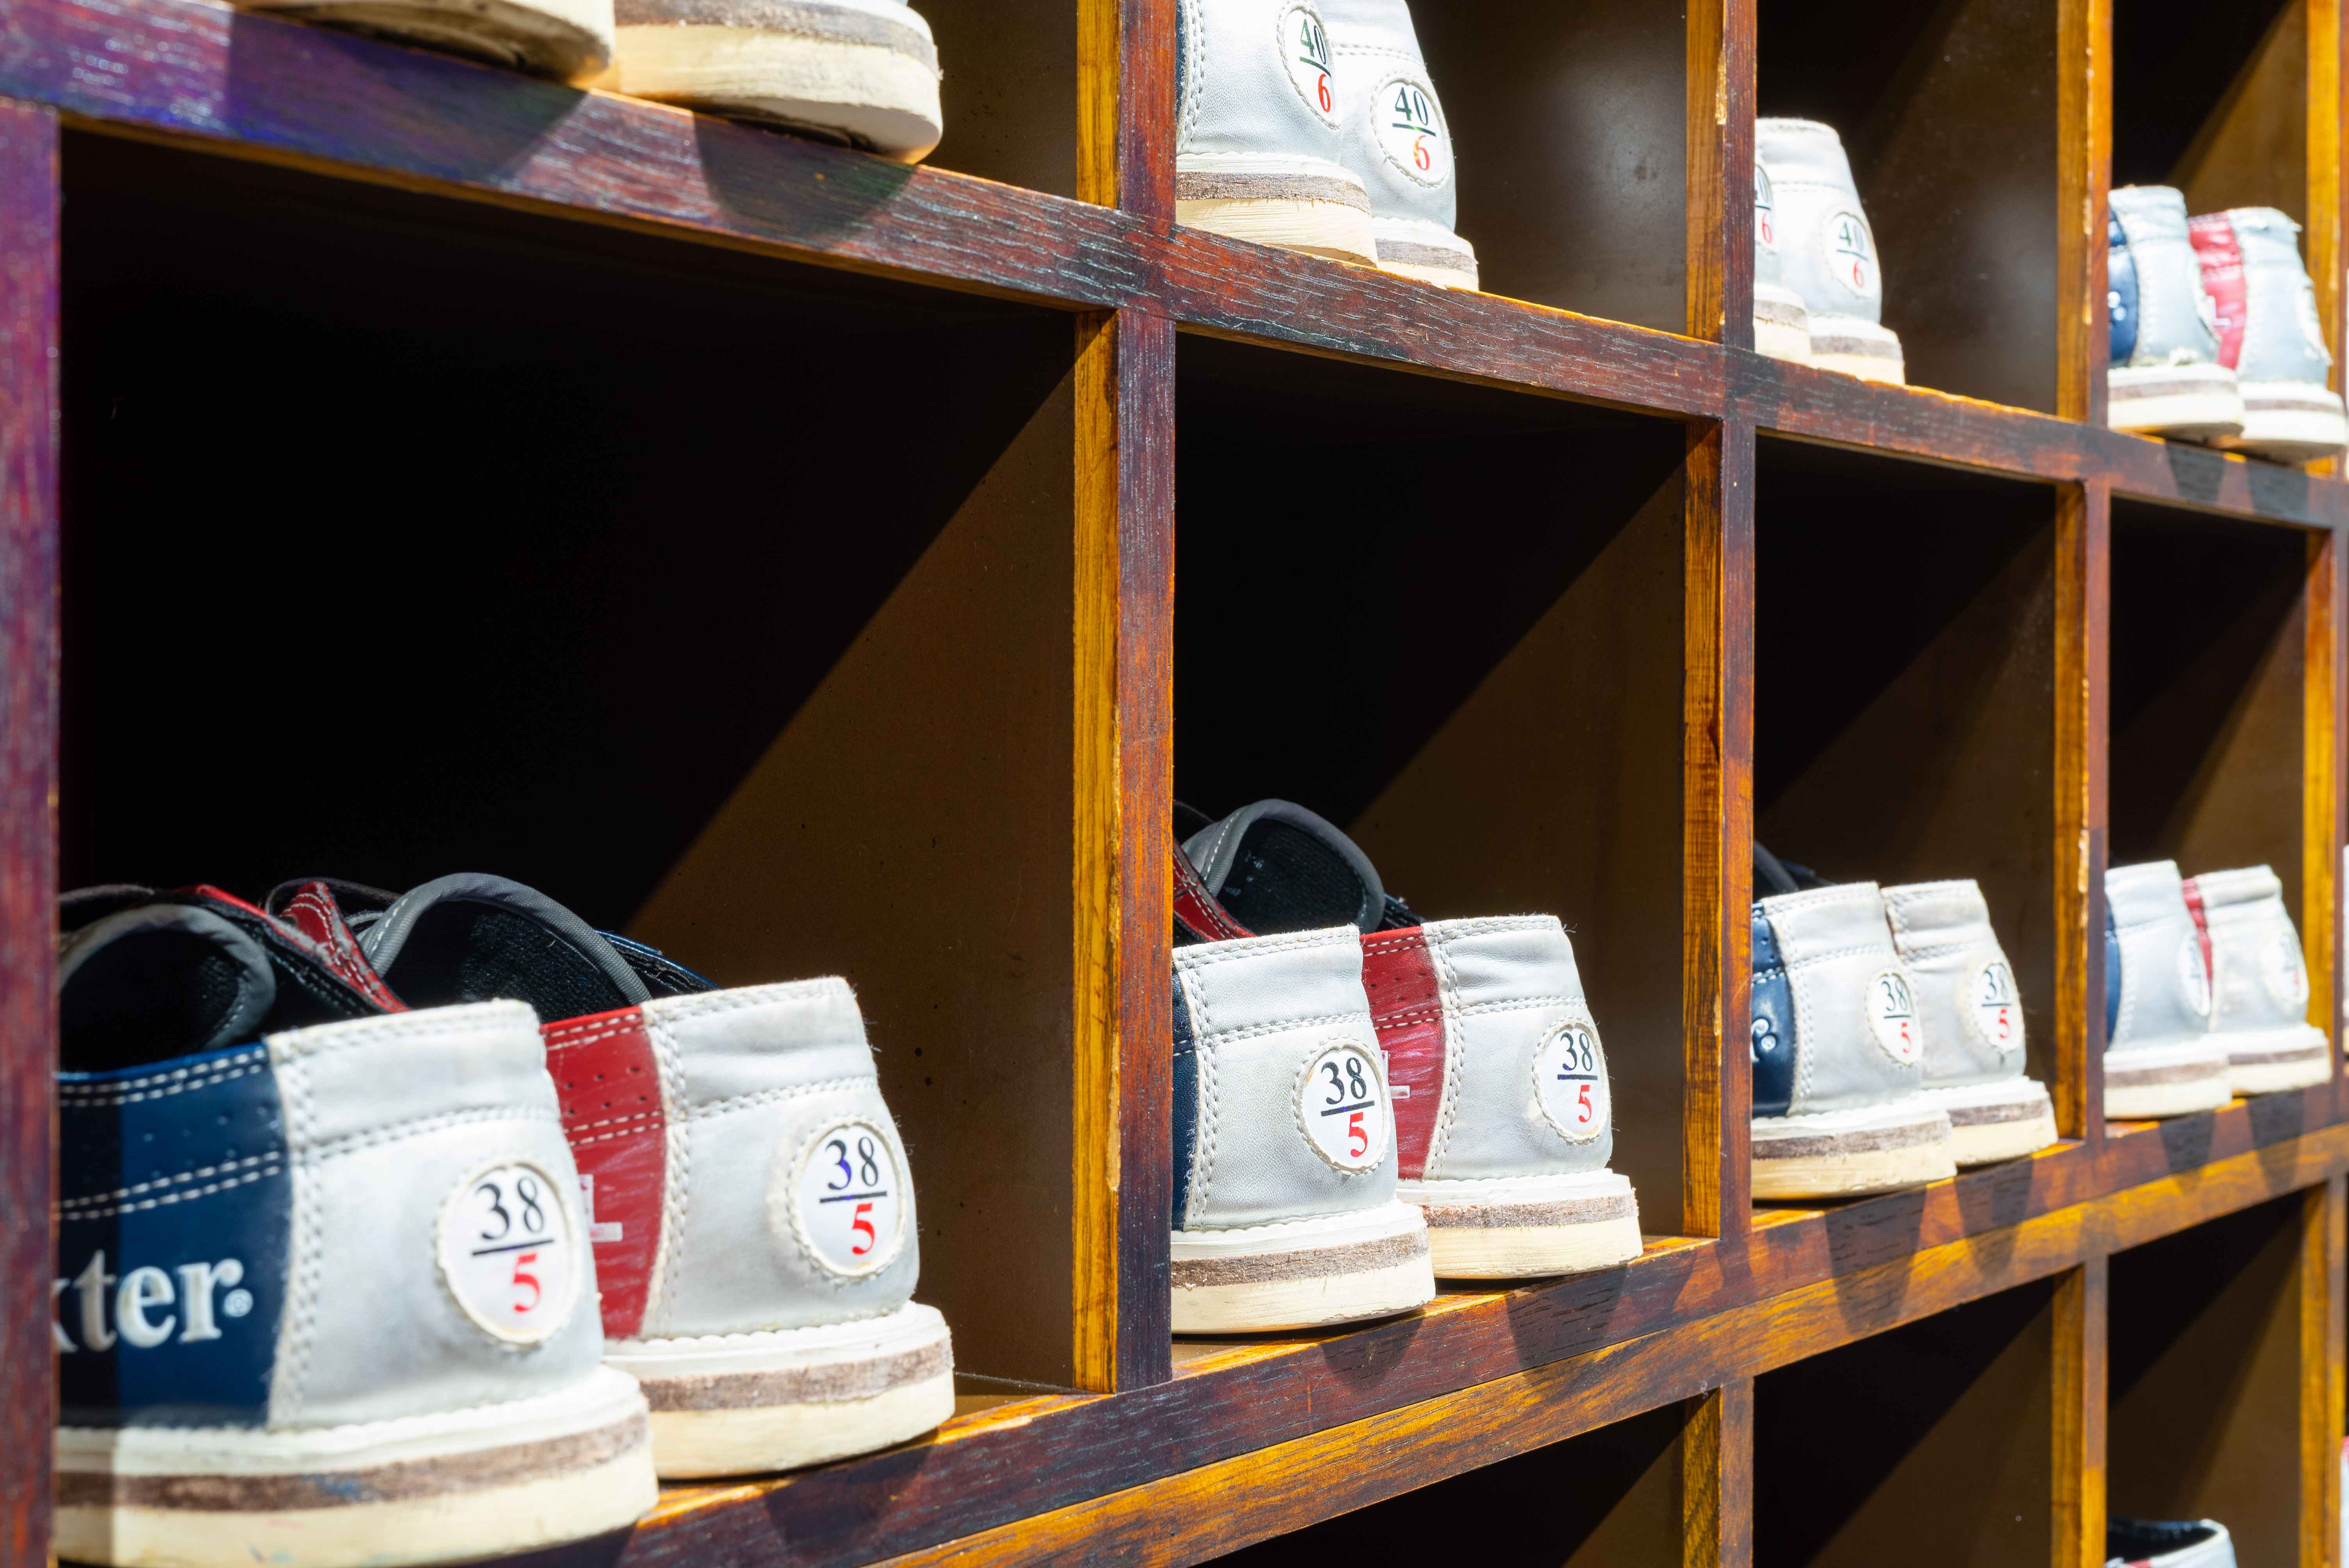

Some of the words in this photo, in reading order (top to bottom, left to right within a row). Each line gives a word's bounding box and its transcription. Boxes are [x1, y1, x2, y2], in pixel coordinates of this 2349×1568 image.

[1300, 18, 1326, 64] 40
[1318, 73, 1331, 113] 6
[1395, 87, 1428, 125] 40
[1413, 135, 1430, 171] 6
[1762, 212, 1772, 243] 6
[1854, 258, 1864, 288] 6
[1881, 980, 1908, 1012] 38
[1982, 968, 2009, 1000] 38
[1901, 1022, 1911, 1054] 5
[1998, 1009, 2010, 1039] 5
[1560, 1032, 1593, 1071] 38
[1321, 1057, 1367, 1105] 38
[1578, 1084, 1592, 1123] 5
[1348, 1112, 1368, 1157] 5
[825, 1137, 879, 1190] 38
[476, 1176, 544, 1240] 38
[852, 1202, 875, 1256] 5
[513, 1253, 541, 1313] 5
